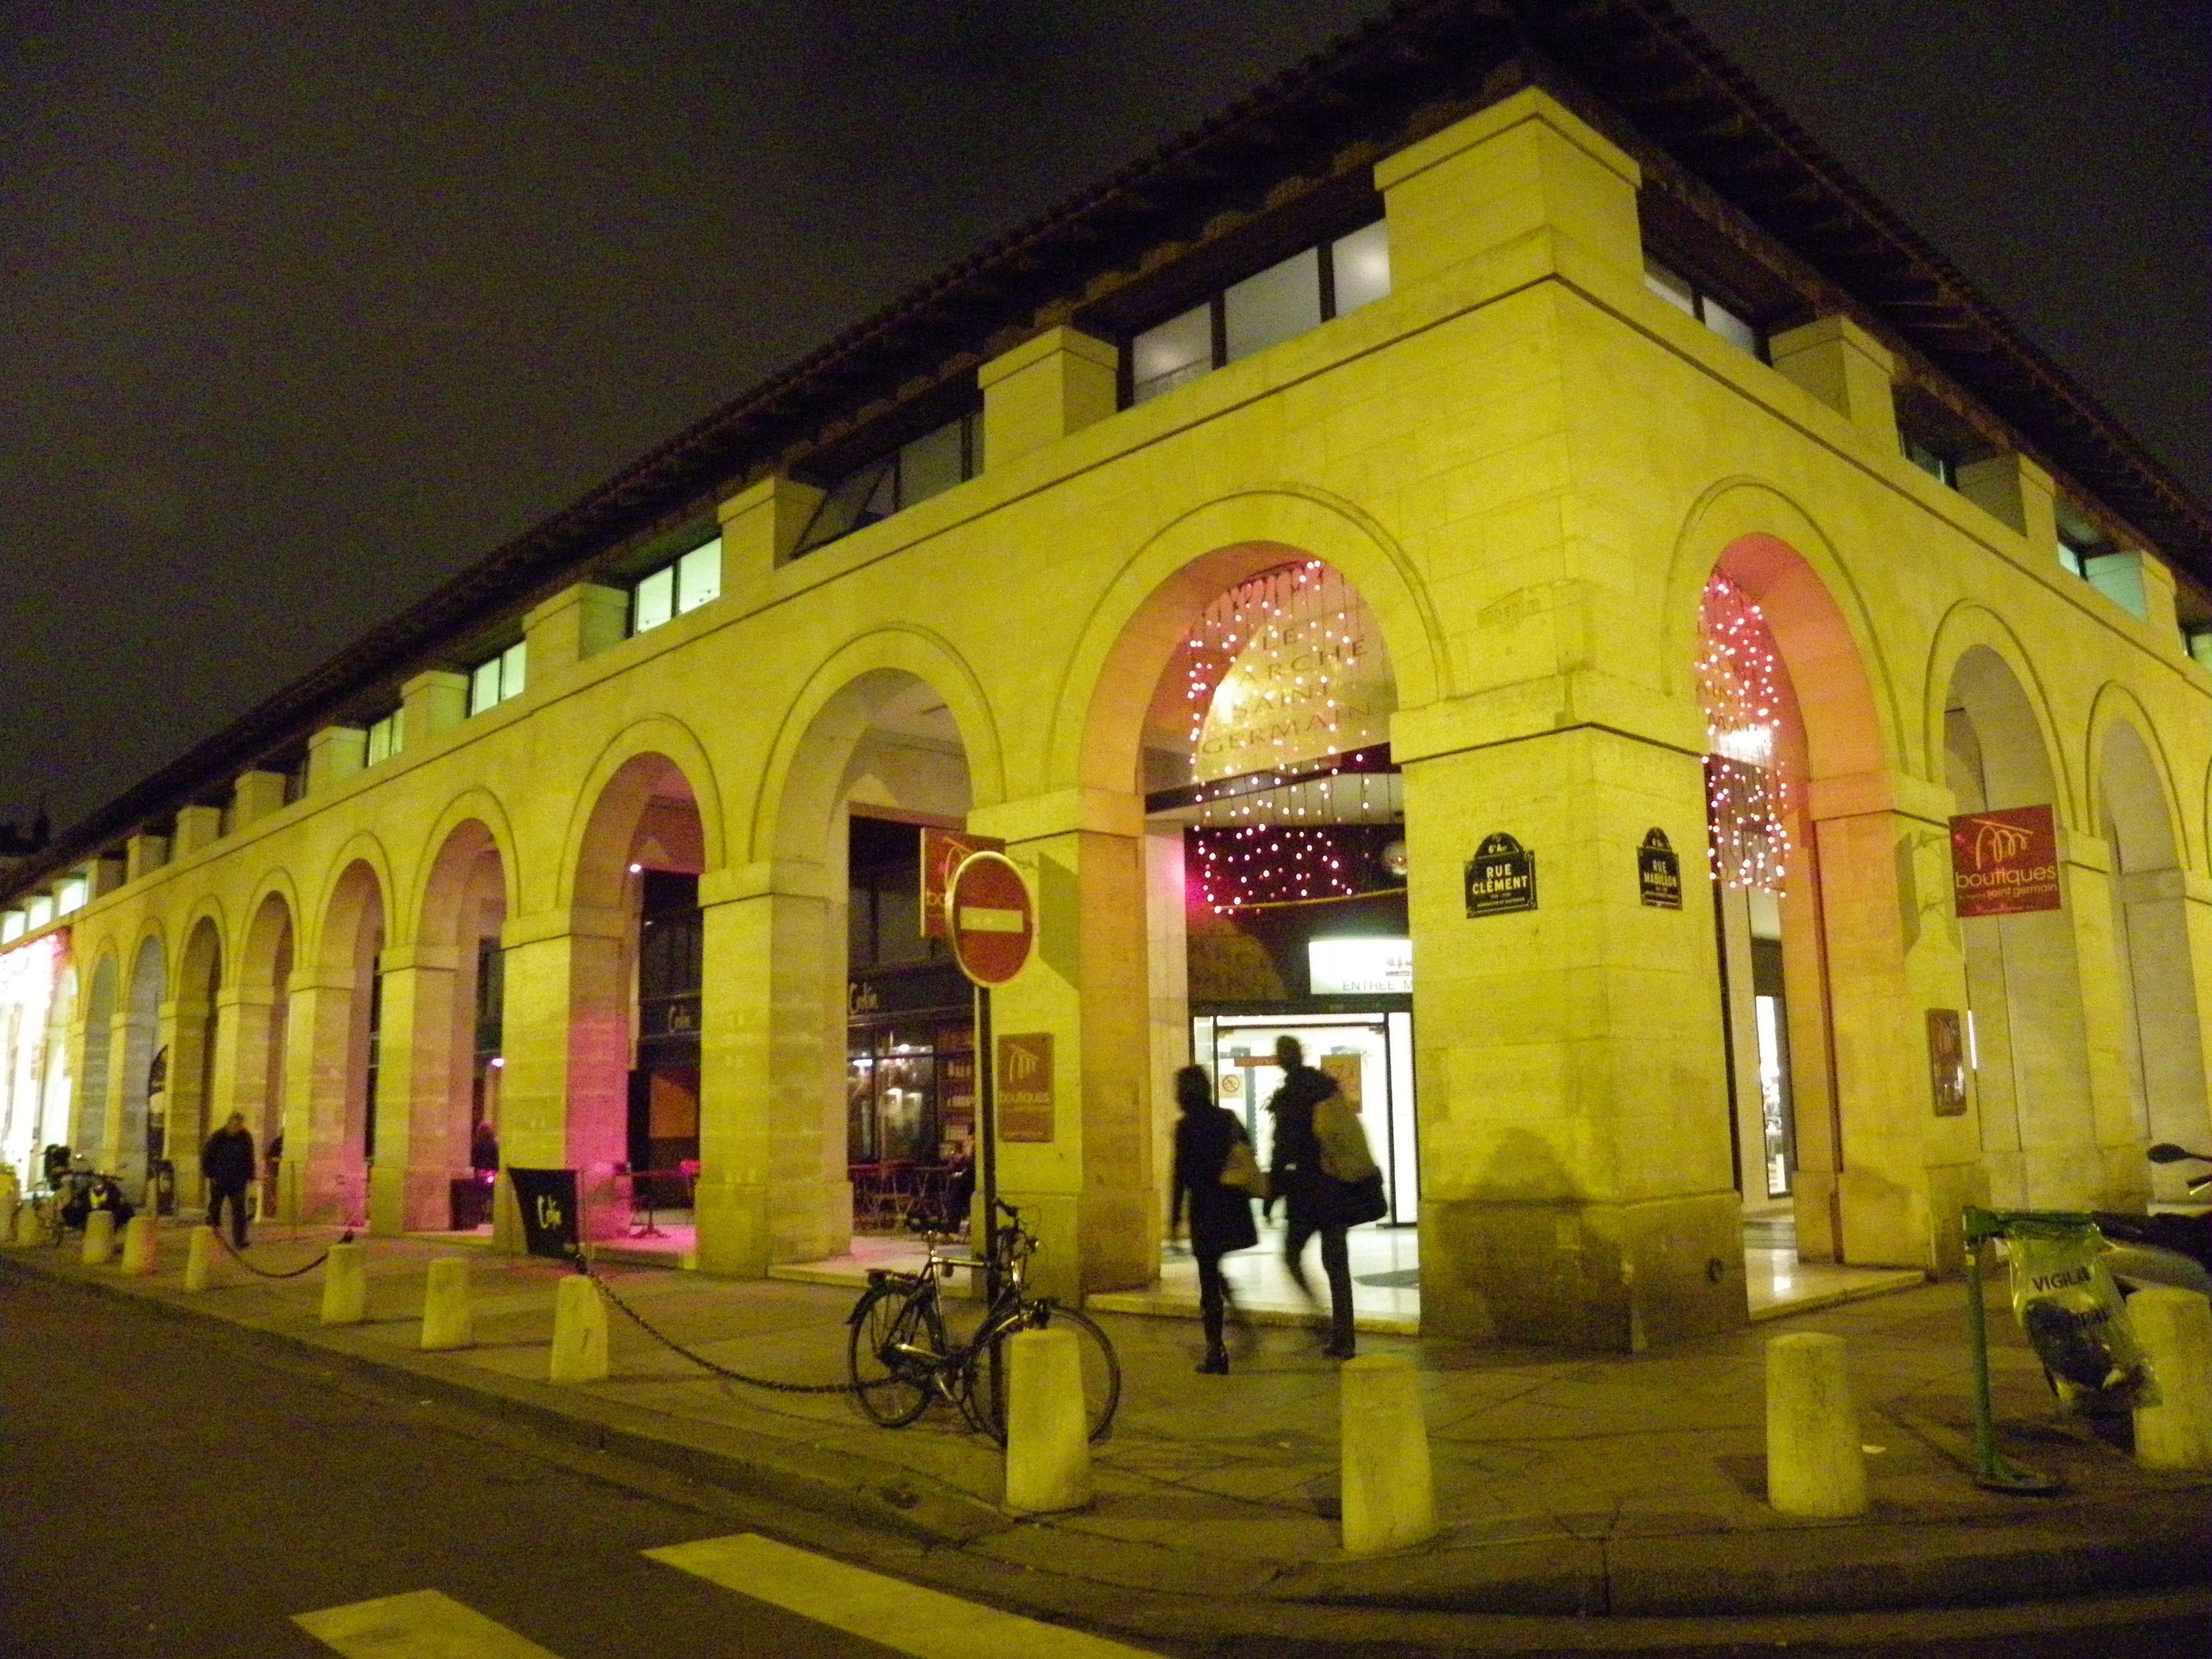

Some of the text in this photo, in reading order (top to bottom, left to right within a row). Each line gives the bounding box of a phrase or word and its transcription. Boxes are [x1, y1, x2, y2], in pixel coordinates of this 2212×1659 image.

[1262, 628, 1297, 651] LE
[1238, 638, 1368, 687] ARCHE
[1486, 863, 1511, 879] RUE
[1652, 859, 1667, 874] RUE
[1955, 865, 2057, 888] boutiques
